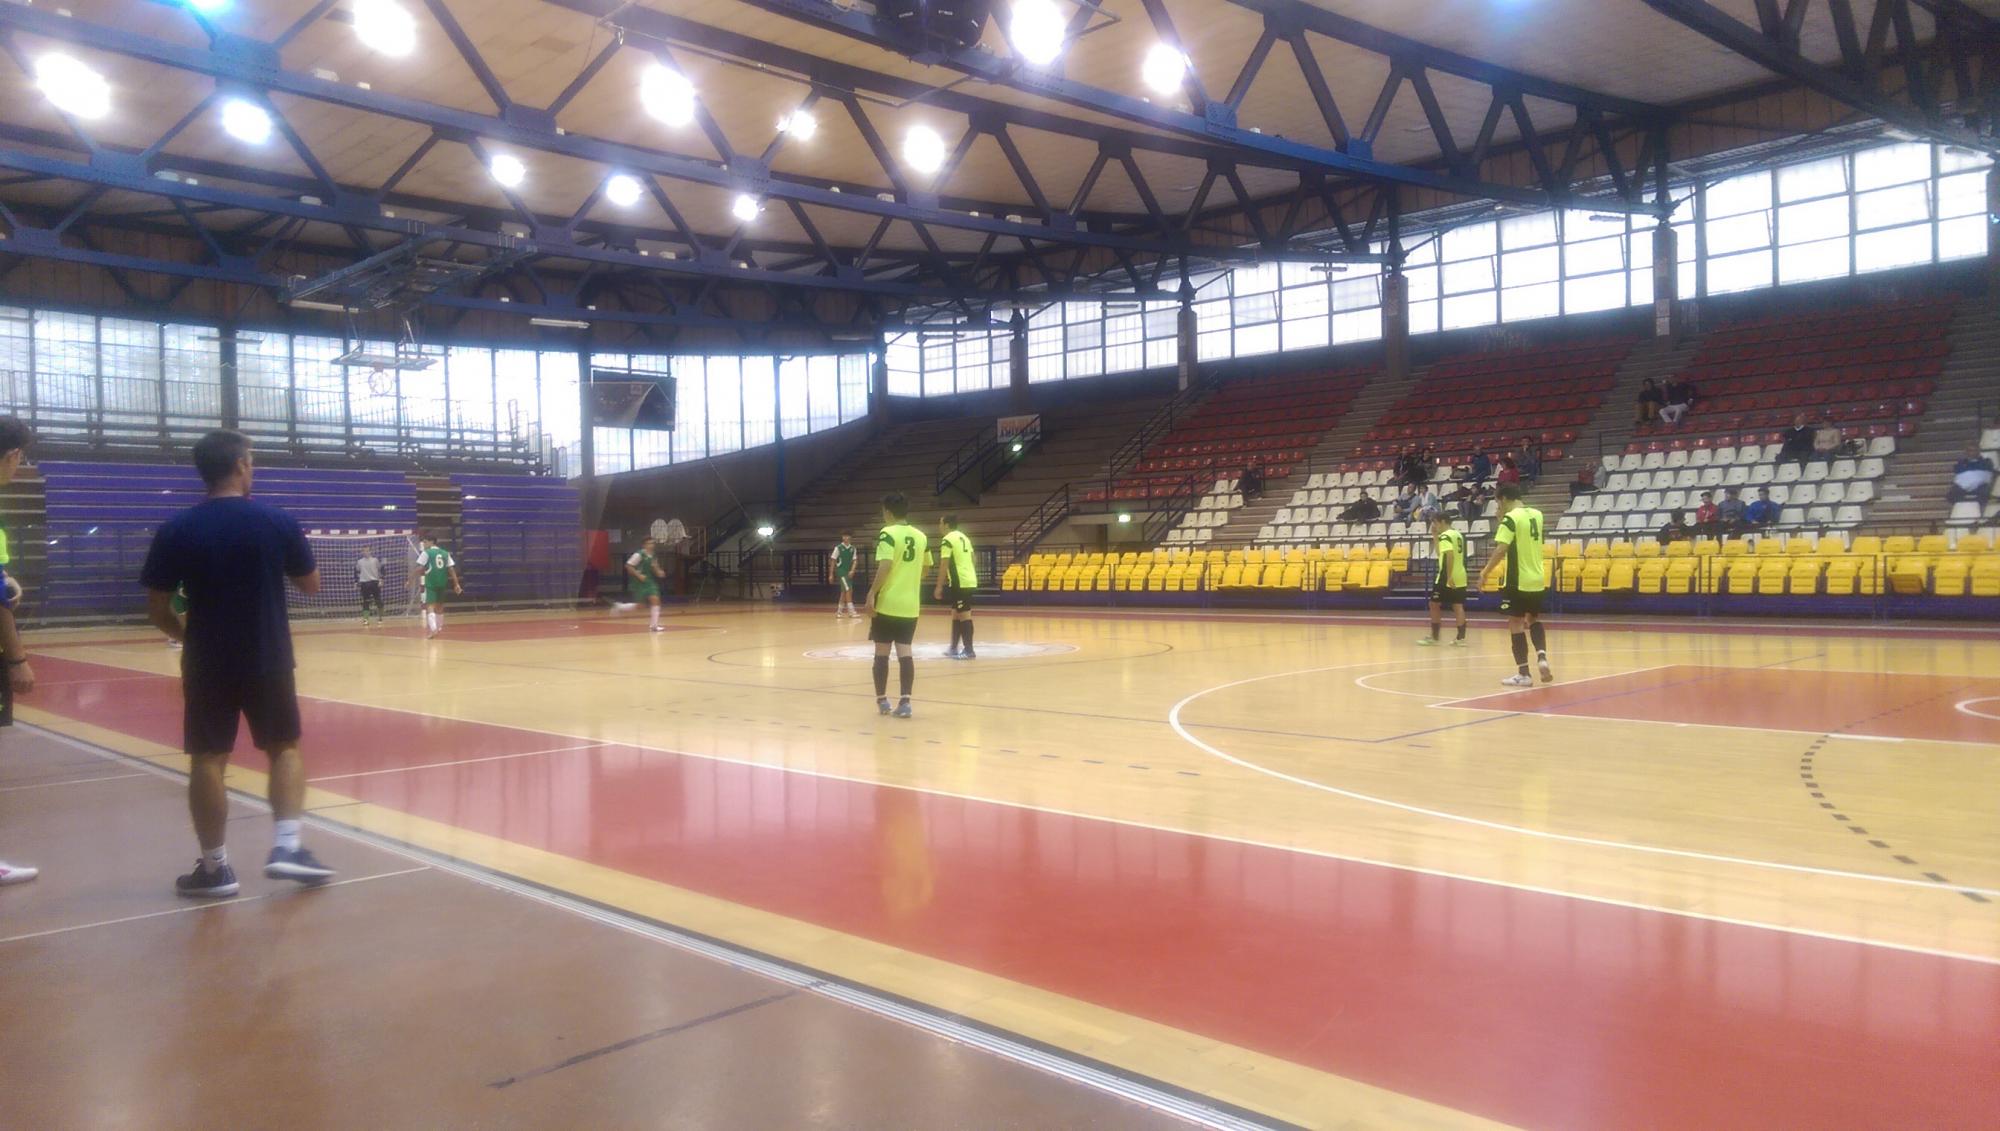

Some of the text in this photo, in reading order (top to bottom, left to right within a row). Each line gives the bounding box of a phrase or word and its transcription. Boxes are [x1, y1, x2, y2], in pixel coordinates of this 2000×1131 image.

[1529, 517, 1539, 541] 4
[903, 536, 915, 562] 3
[435, 554, 444, 569] 6
